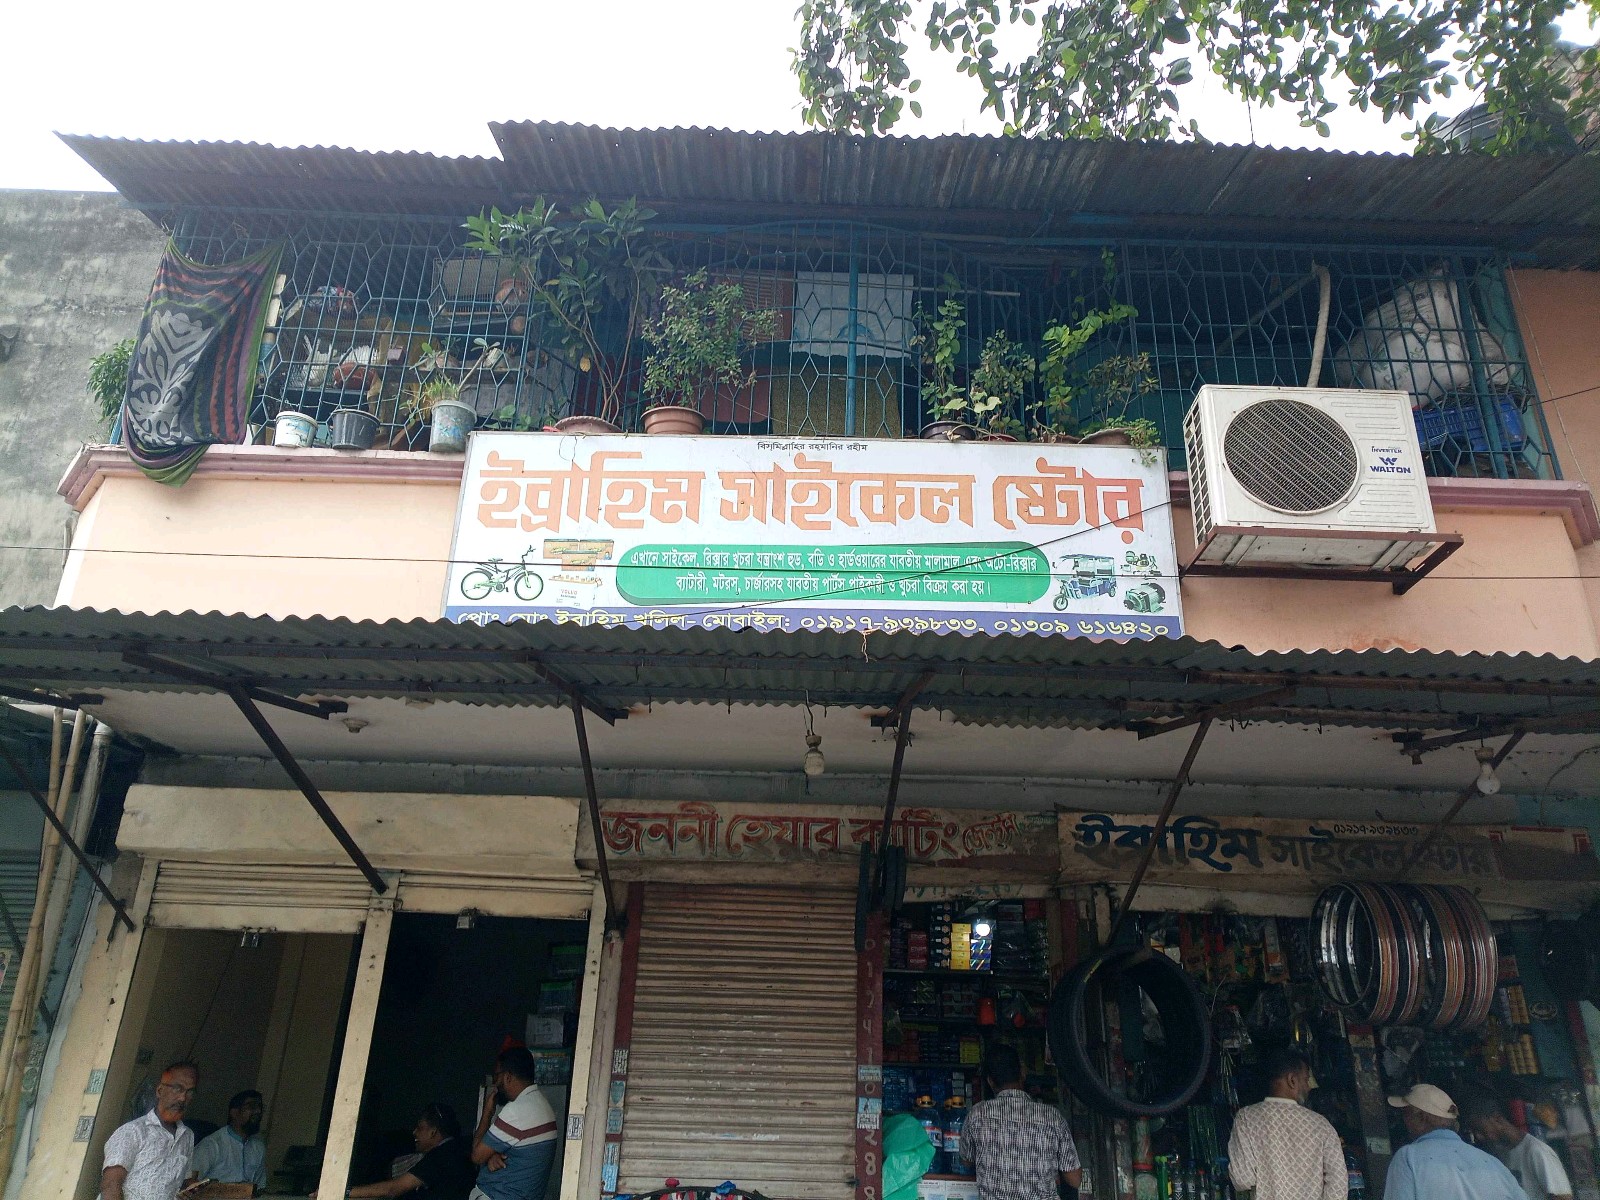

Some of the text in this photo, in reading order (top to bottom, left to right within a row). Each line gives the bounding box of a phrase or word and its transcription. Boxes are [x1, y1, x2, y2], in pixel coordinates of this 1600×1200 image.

[1370, 466, 1411, 474] WALTON
[477, 450, 706, 533] ইব্রাহিম
[718, 452, 976, 530] সাইকেল
[631, 551, 659, 566] এখানে
[733, 552, 753, 569] খুচরা
[757, 552, 785, 568] যন্ত্রাংশ
[807, 548, 825, 567] বডি
[828, 554, 835, 567] ও
[889, 549, 922, 569] যাবতীয়
[924, 554, 960, 570] মালামাল
[964, 555, 983, 571] এবং
[744, 572, 784, 593] চার্জারসহ
[786, 572, 819, 592] যাবতীয়
[849, 574, 885, 594] পাইকারী
[888, 581, 896, 592] ও
[899, 579, 920, 597] খুচরা
[923, 575, 948, 595] বিক্রয়
[951, 580, 968, 595] করা
[994, 619, 1070, 633] ০১৩০৯
[600, 801, 722, 855] জননী
